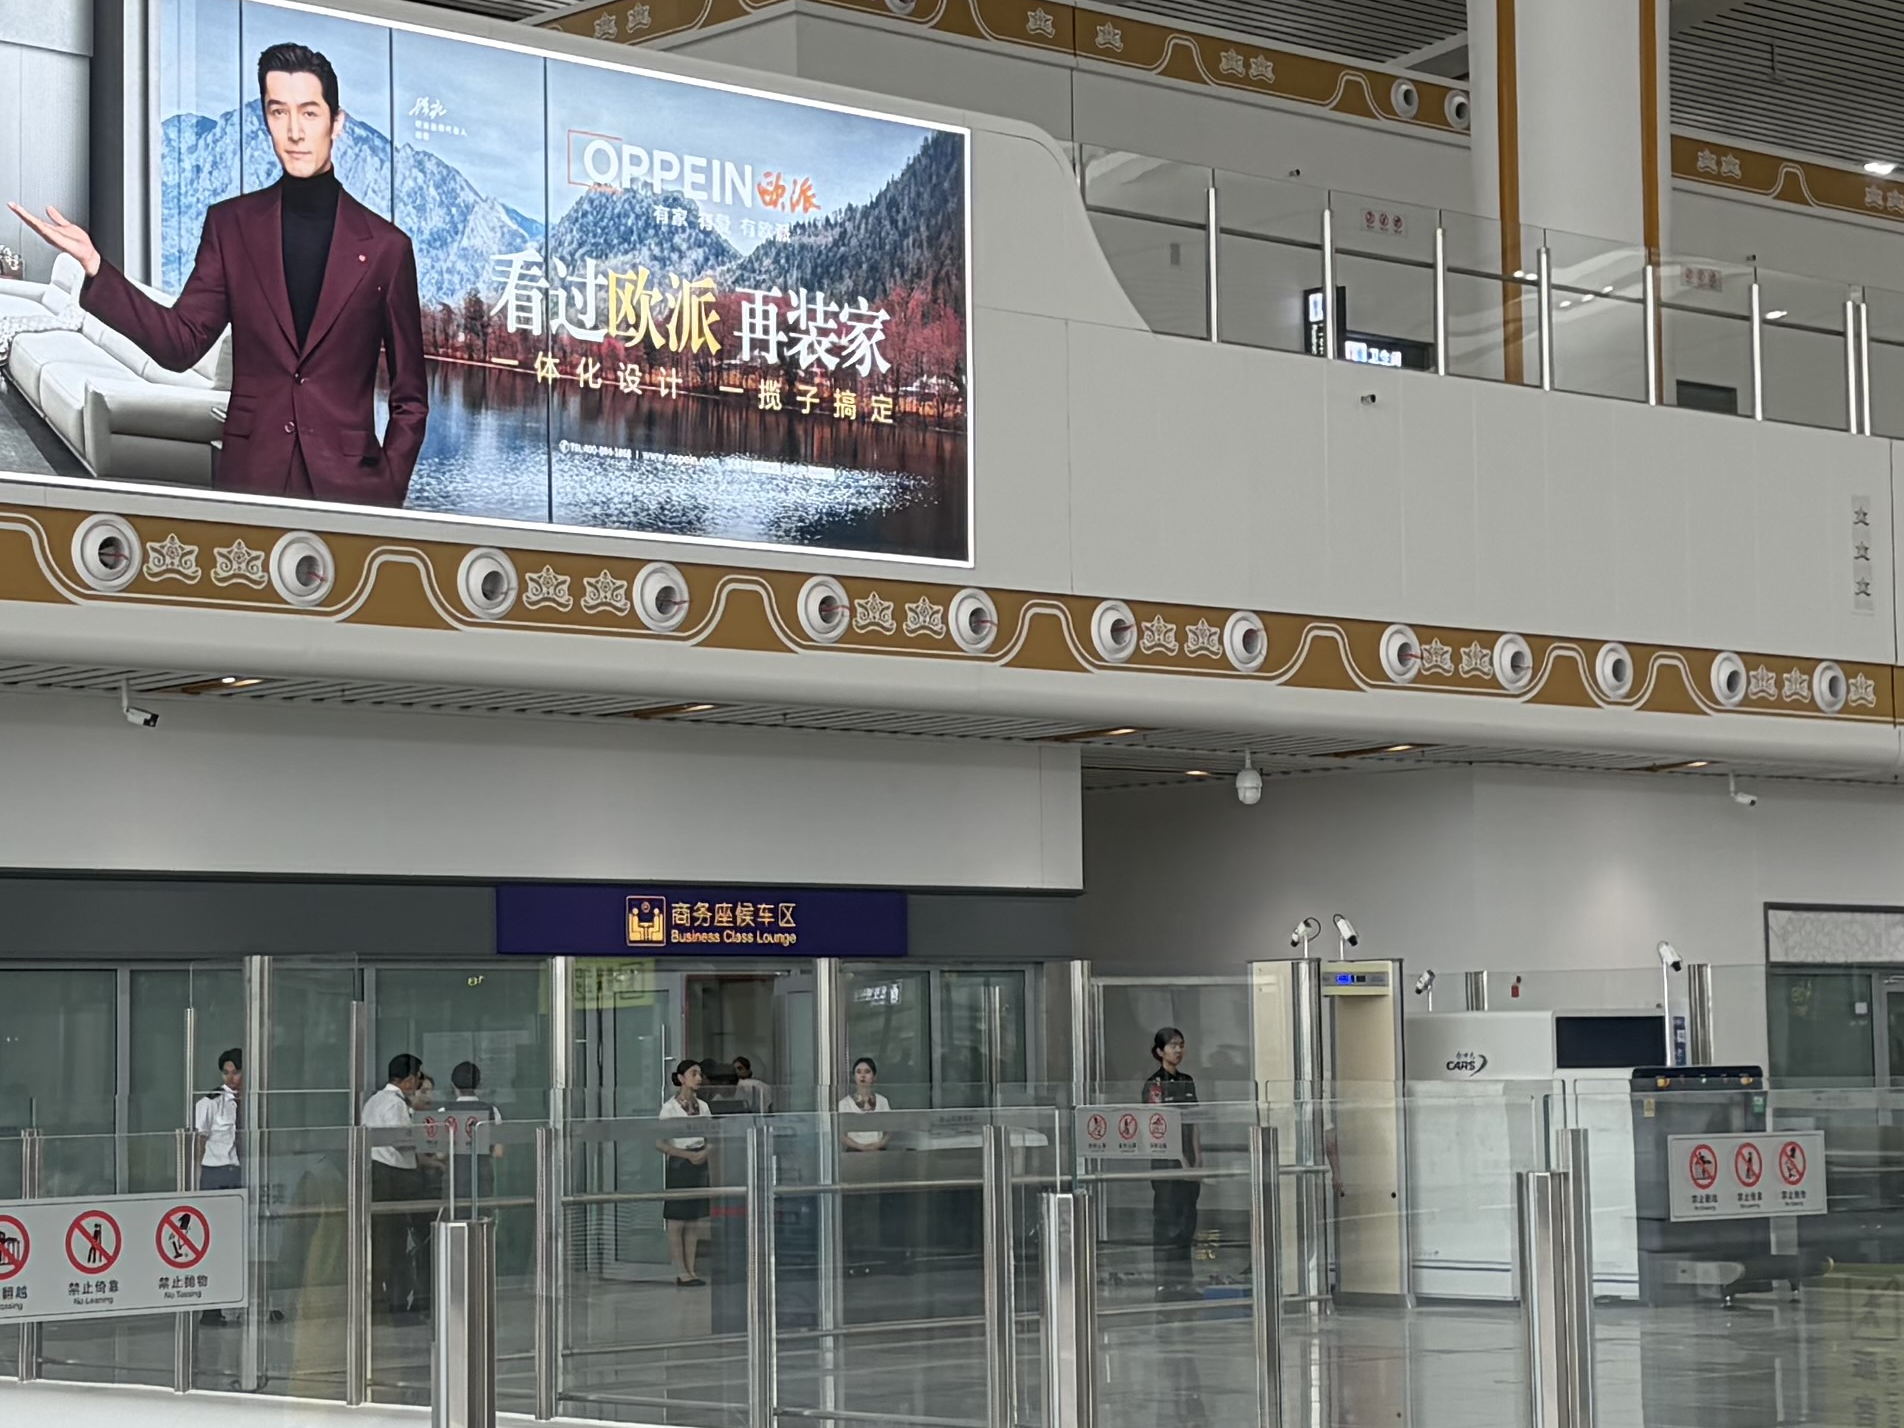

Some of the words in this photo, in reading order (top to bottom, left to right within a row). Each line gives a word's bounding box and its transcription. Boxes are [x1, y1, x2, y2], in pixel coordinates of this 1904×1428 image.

[584, 139, 752, 208] OPPEIN
[490, 248, 721, 355] 看过欧派
[734, 285, 891, 377] 再装家
[491, 351, 683, 399] 一体化设计
[719, 380, 895, 424] 一揽子搞定
[671, 902, 796, 927] 商务座候车区
[671, 930, 721, 943] Business
[723, 930, 754, 943] Class
[757, 930, 797, 947] Lounge
